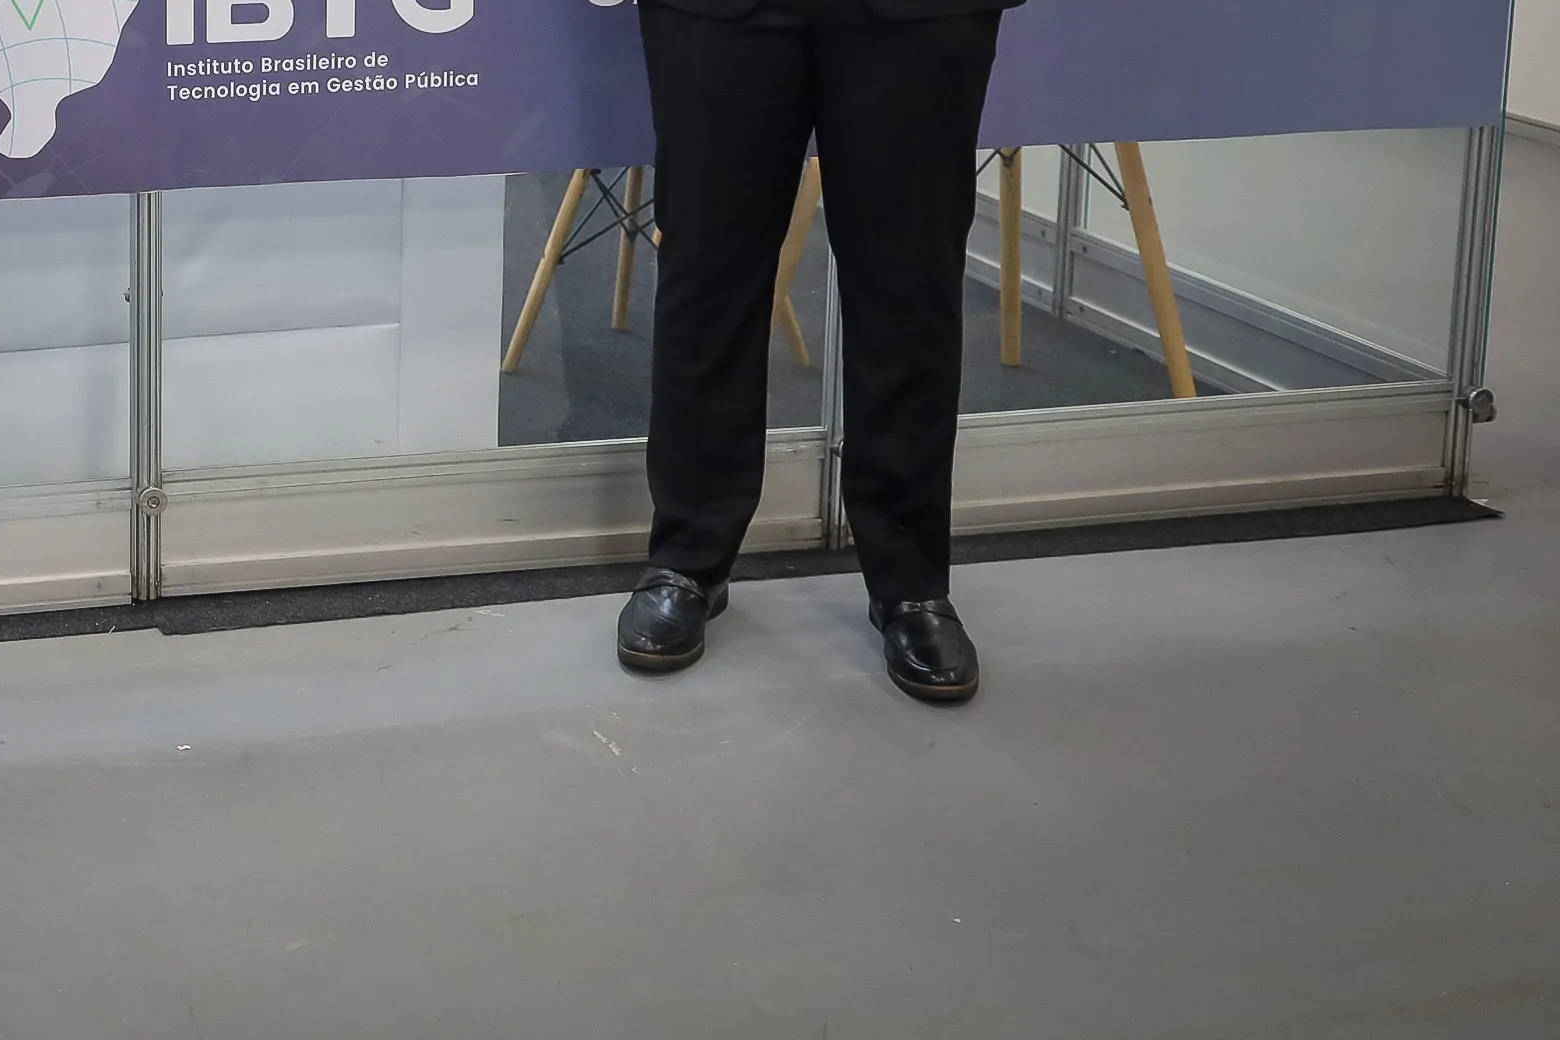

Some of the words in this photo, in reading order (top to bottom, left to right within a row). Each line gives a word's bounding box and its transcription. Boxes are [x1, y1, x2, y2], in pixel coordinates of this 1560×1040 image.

[166, 59, 254, 77] Instituto
[260, 53, 357, 74] Brasileiro
[363, 51, 389, 68] de
[166, 79, 281, 102] Tecnologia
[287, 81, 319, 95] em
[326, 74, 398, 93] Gestão
[404, 70, 479, 89] Pública
